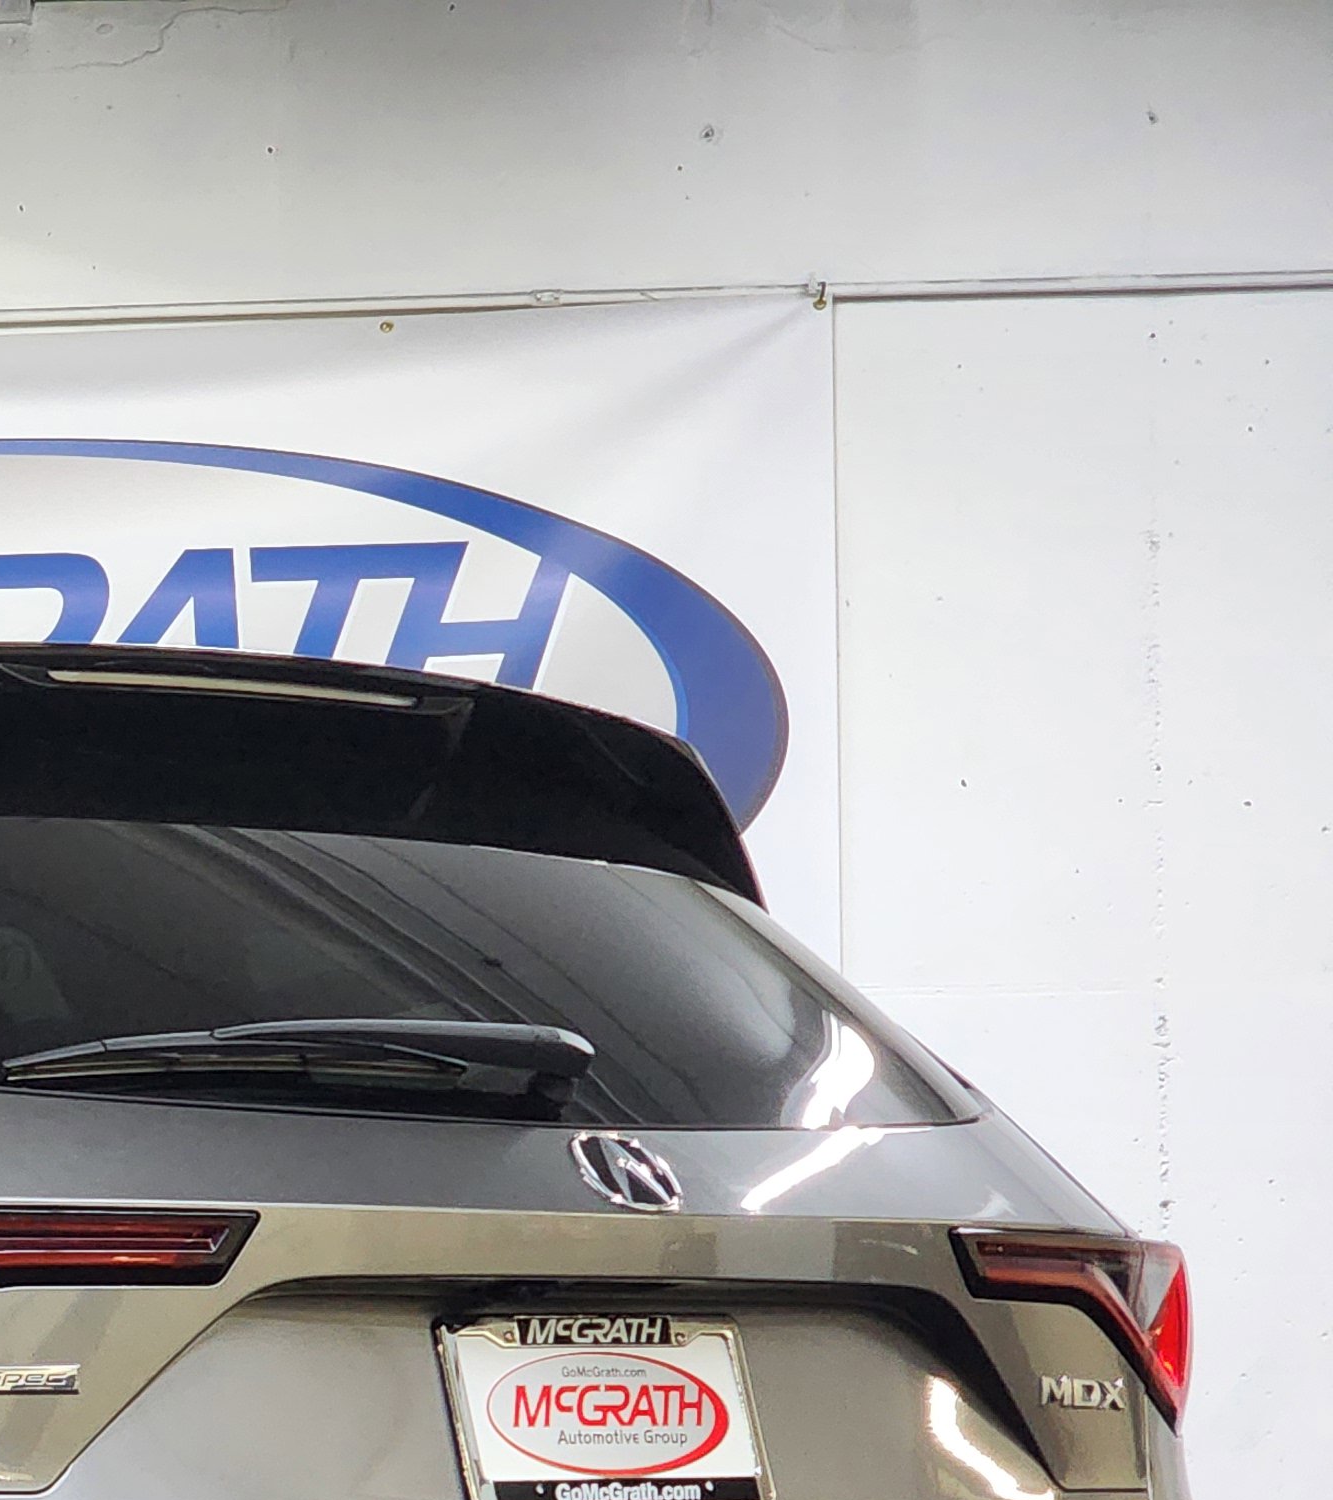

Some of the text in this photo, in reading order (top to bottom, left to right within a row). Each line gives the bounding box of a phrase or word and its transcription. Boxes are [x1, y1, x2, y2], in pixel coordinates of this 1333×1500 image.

[561, 1366, 647, 1378] GoMcGrath.com
[1040, 1374, 1126, 1411] MDX
[557, 1430, 688, 1447] Automotive Group
